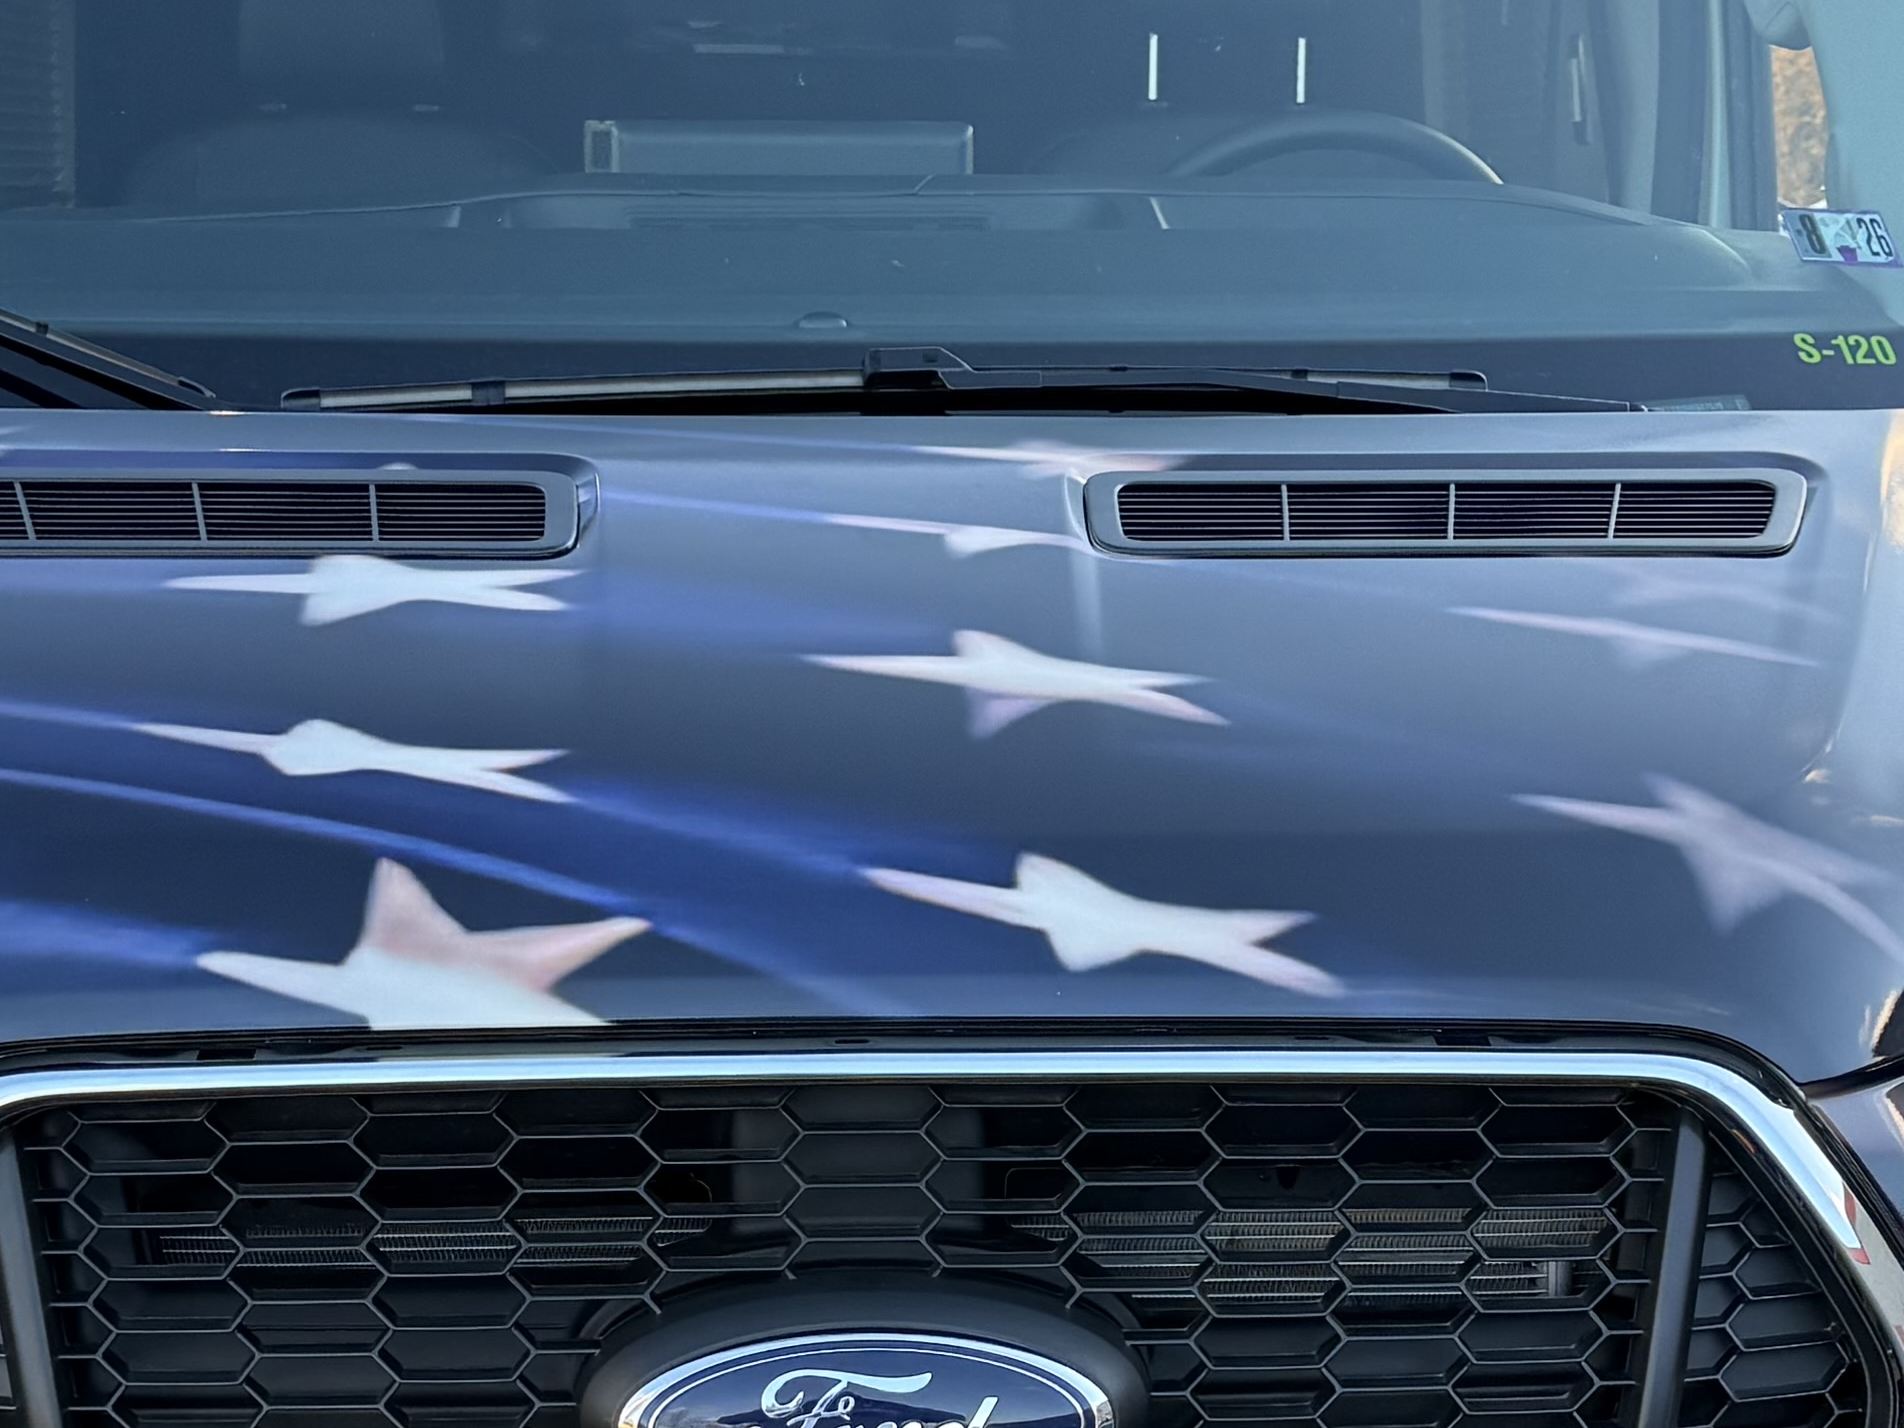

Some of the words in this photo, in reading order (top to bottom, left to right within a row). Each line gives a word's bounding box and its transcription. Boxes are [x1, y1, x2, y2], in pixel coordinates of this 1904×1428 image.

[1799, 214, 1826, 254] 8
[1856, 217, 1893, 257] 26
[1793, 333, 1897, 365] S-120
